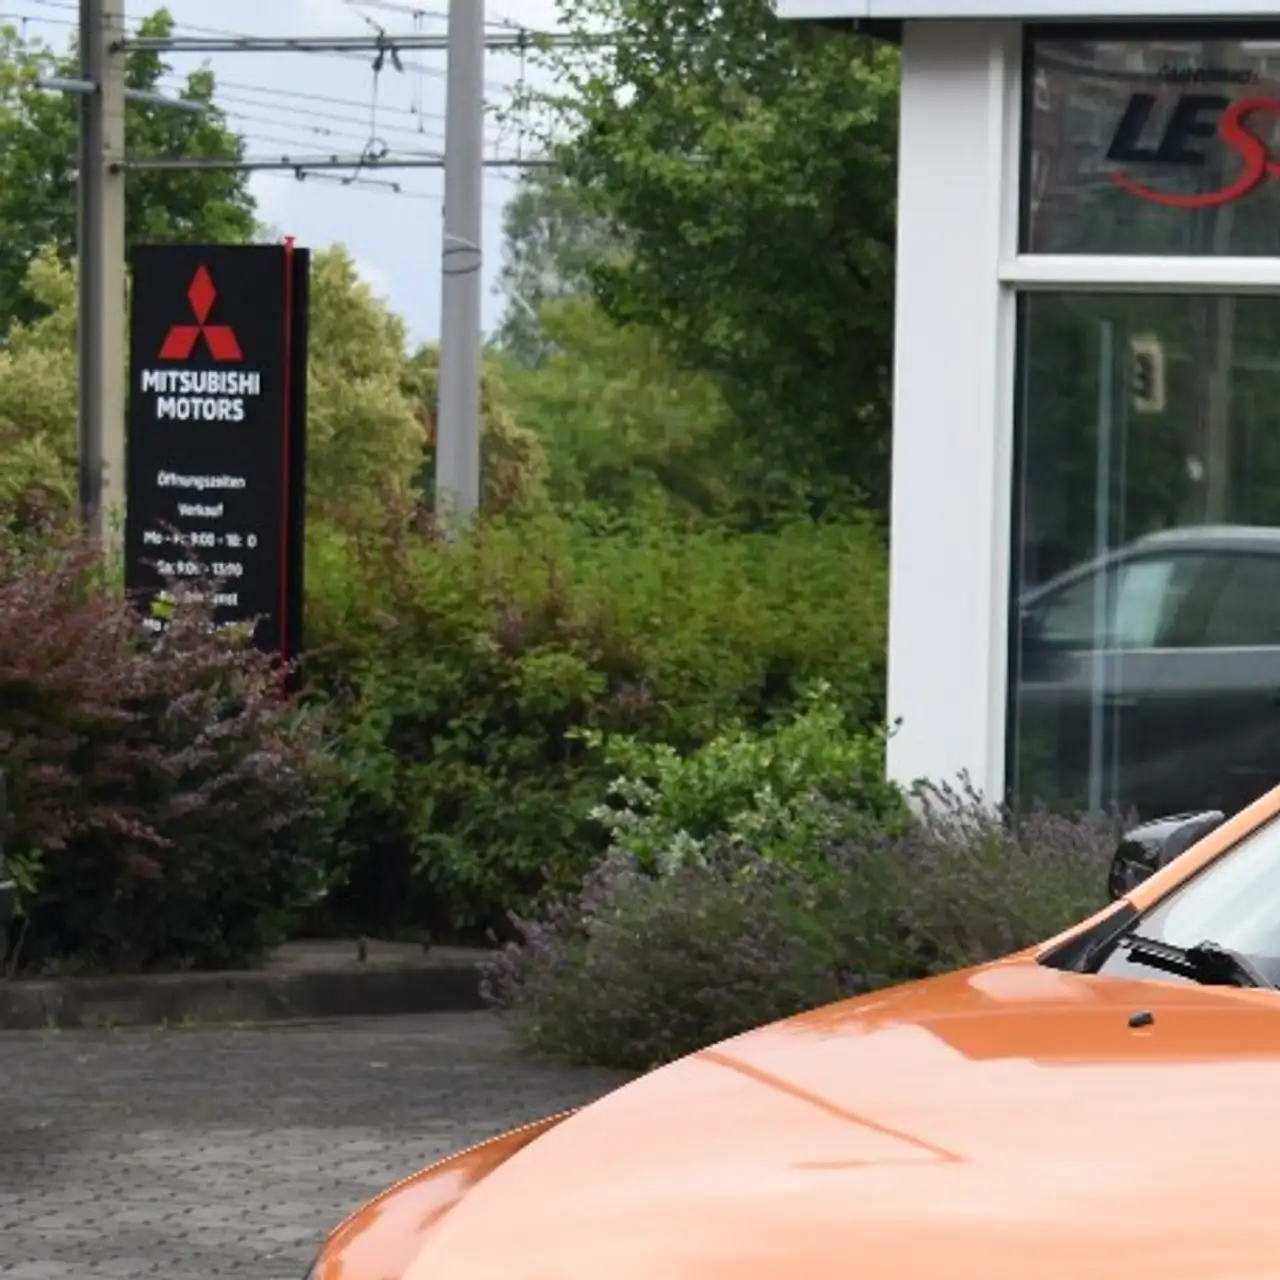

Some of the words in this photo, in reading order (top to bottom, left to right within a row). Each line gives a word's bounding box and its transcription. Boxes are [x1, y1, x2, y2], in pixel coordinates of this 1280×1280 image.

[142, 369, 260, 395] MITSUBISHI
[157, 396, 245, 421] MOTORS
[157, 469, 246, 491] Öffnungszeiten
[177, 502, 224, 517] Verkauf
